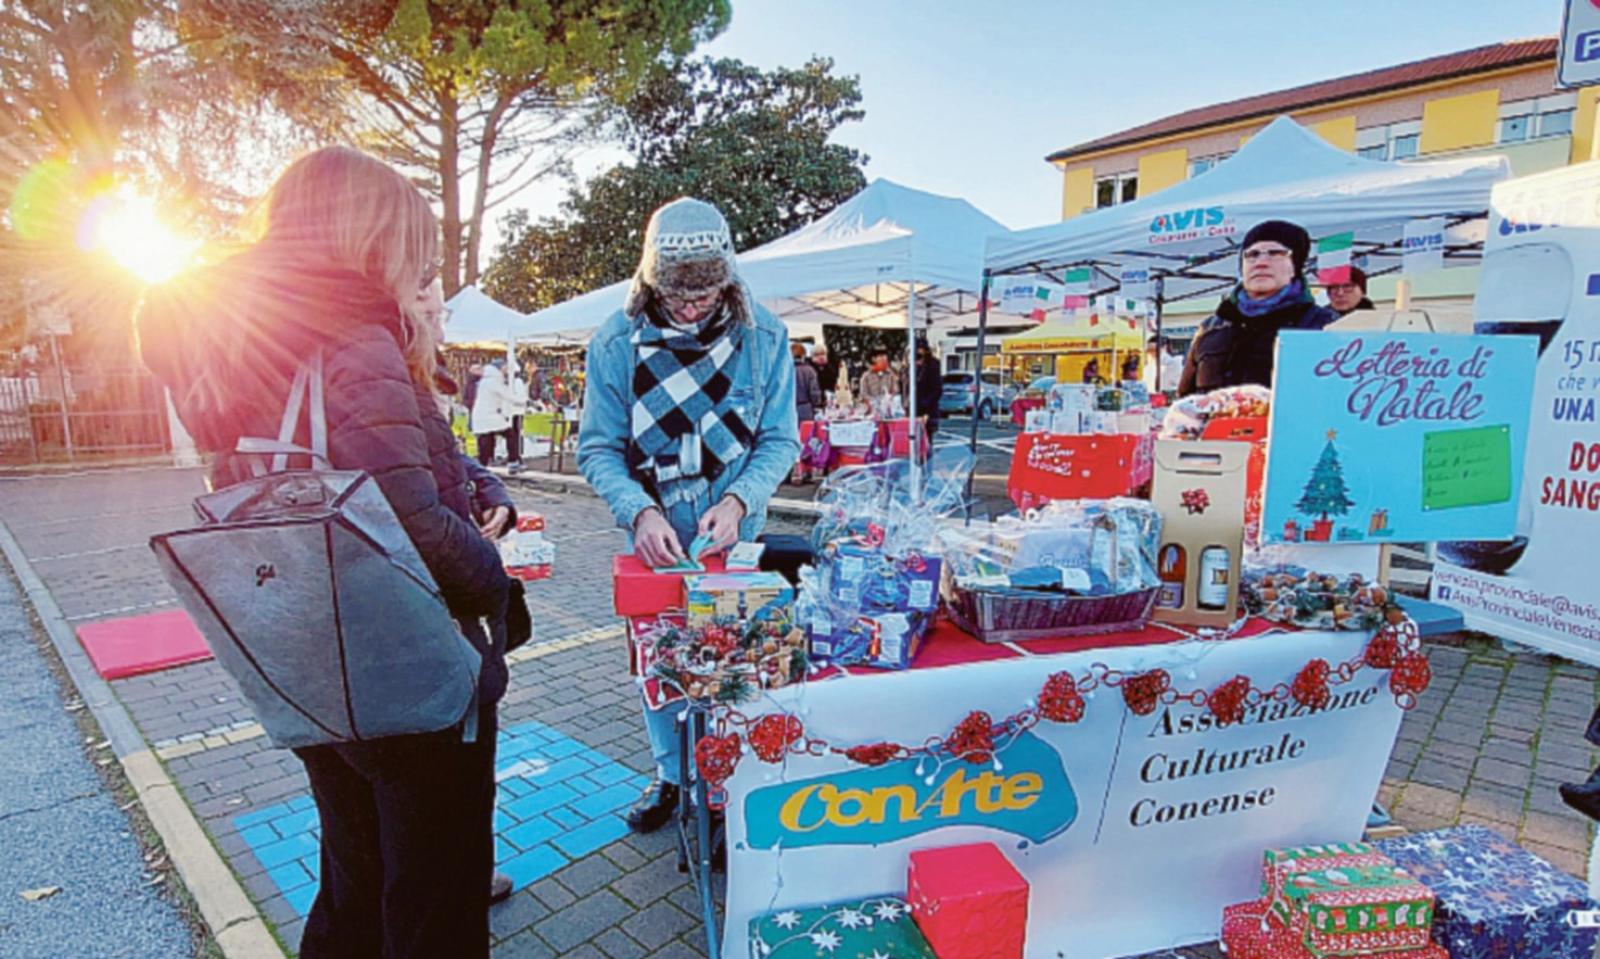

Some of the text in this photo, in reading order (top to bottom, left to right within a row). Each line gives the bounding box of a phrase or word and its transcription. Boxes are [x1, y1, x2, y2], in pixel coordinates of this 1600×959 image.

[1150, 205, 1225, 234] AVIS
[1314, 338, 1494, 384] Lotteria di
[1563, 339, 1585, 370] 15
[1347, 376, 1486, 427] Natale
[1558, 372, 1586, 391] che
[1552, 397, 1595, 421] UNA
[1568, 441, 1600, 473] DO
[1147, 686, 1378, 738] Assciazone
[1140, 732, 1306, 784] Culturale
[779, 768, 1044, 833] ConArte
[1129, 786, 1275, 828] Conense
